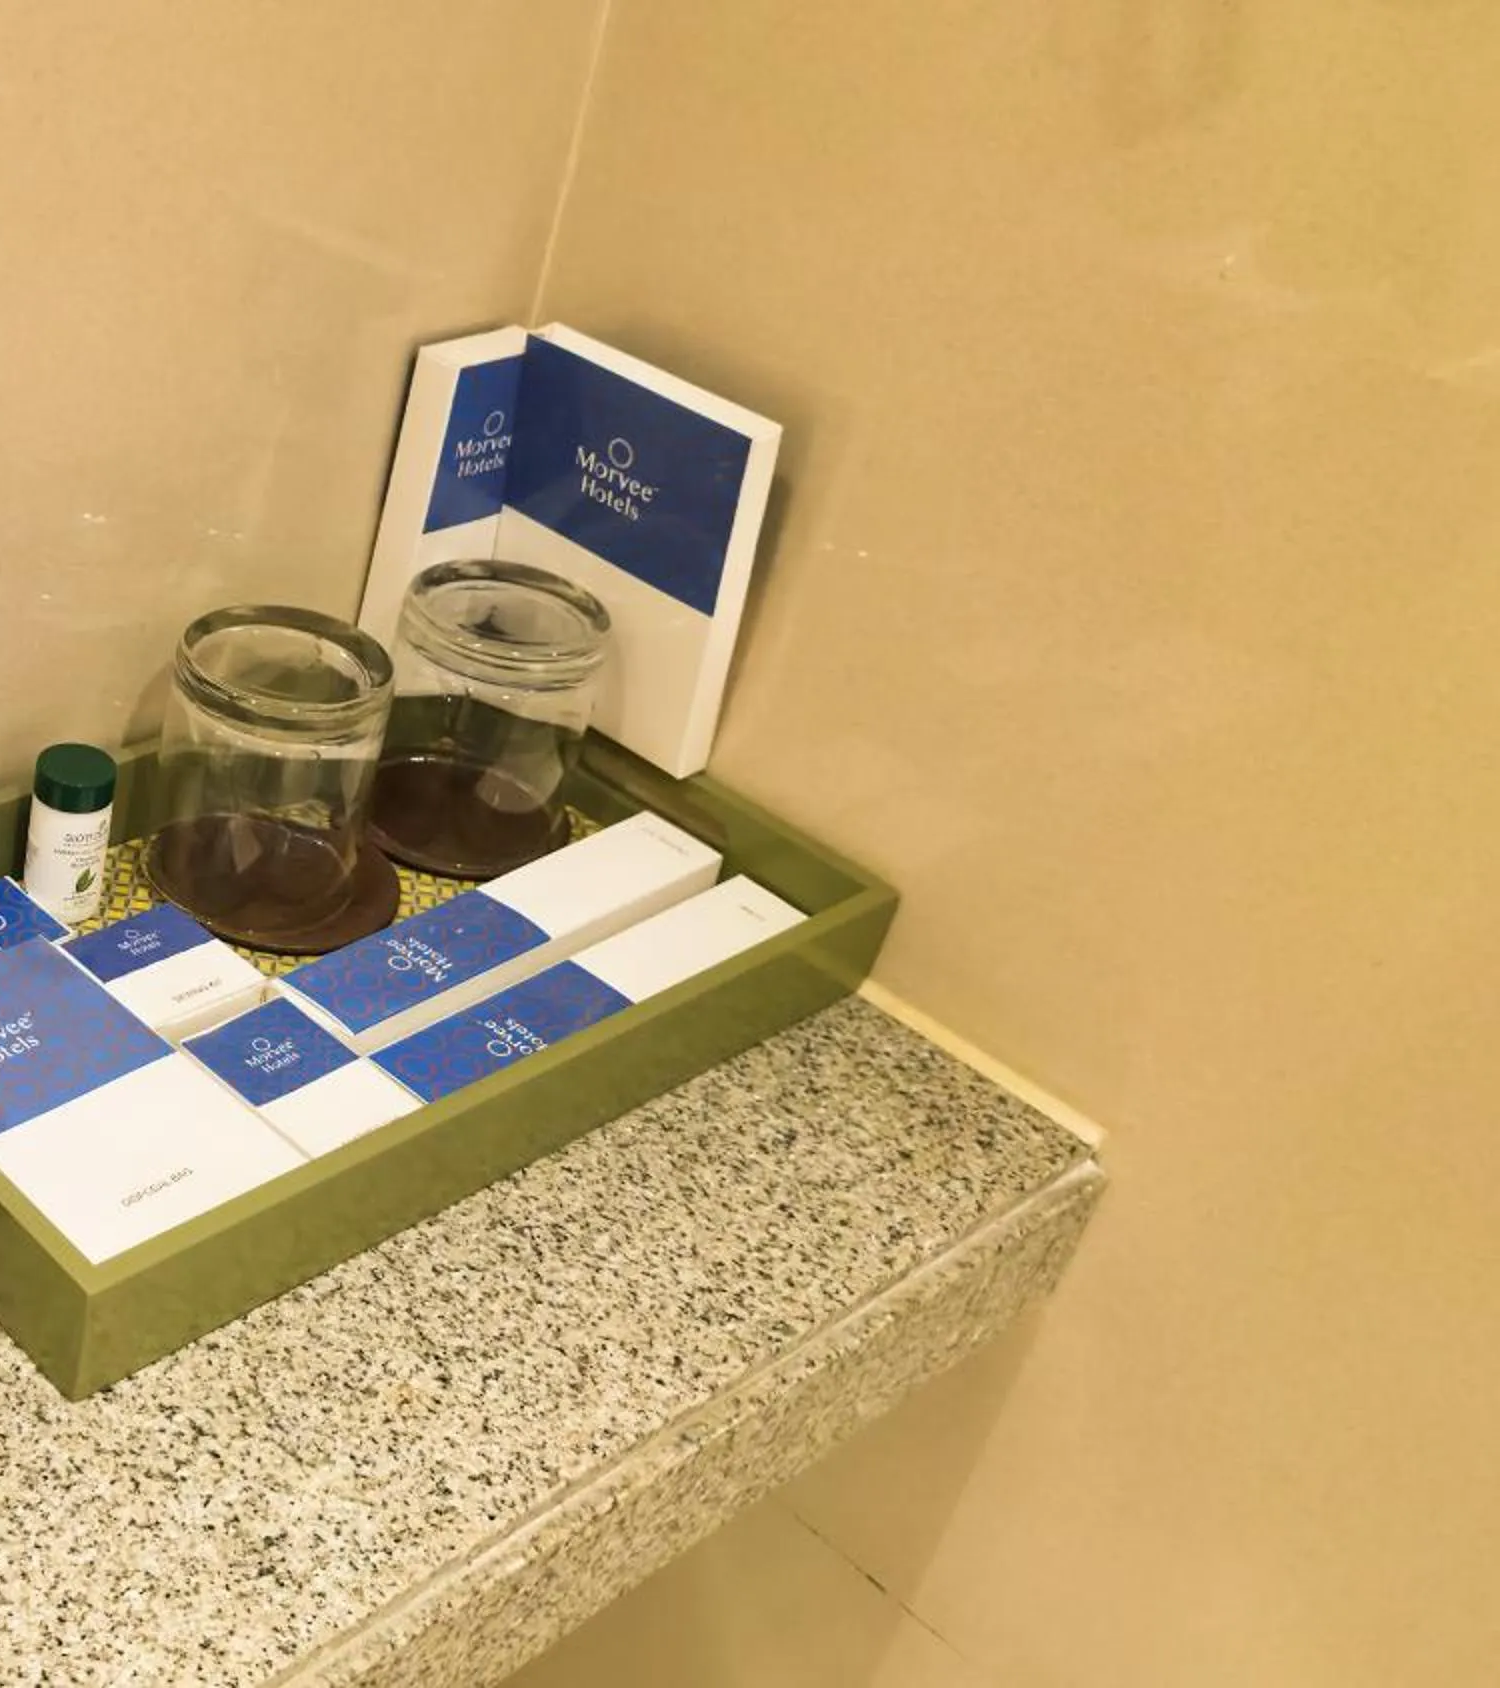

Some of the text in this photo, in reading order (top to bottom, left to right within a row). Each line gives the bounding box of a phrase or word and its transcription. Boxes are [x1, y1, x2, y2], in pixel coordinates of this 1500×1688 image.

[575, 445, 654, 502] Morvee
[581, 475, 639, 521] Hotels
[484, 1019, 533, 1055] orvee
